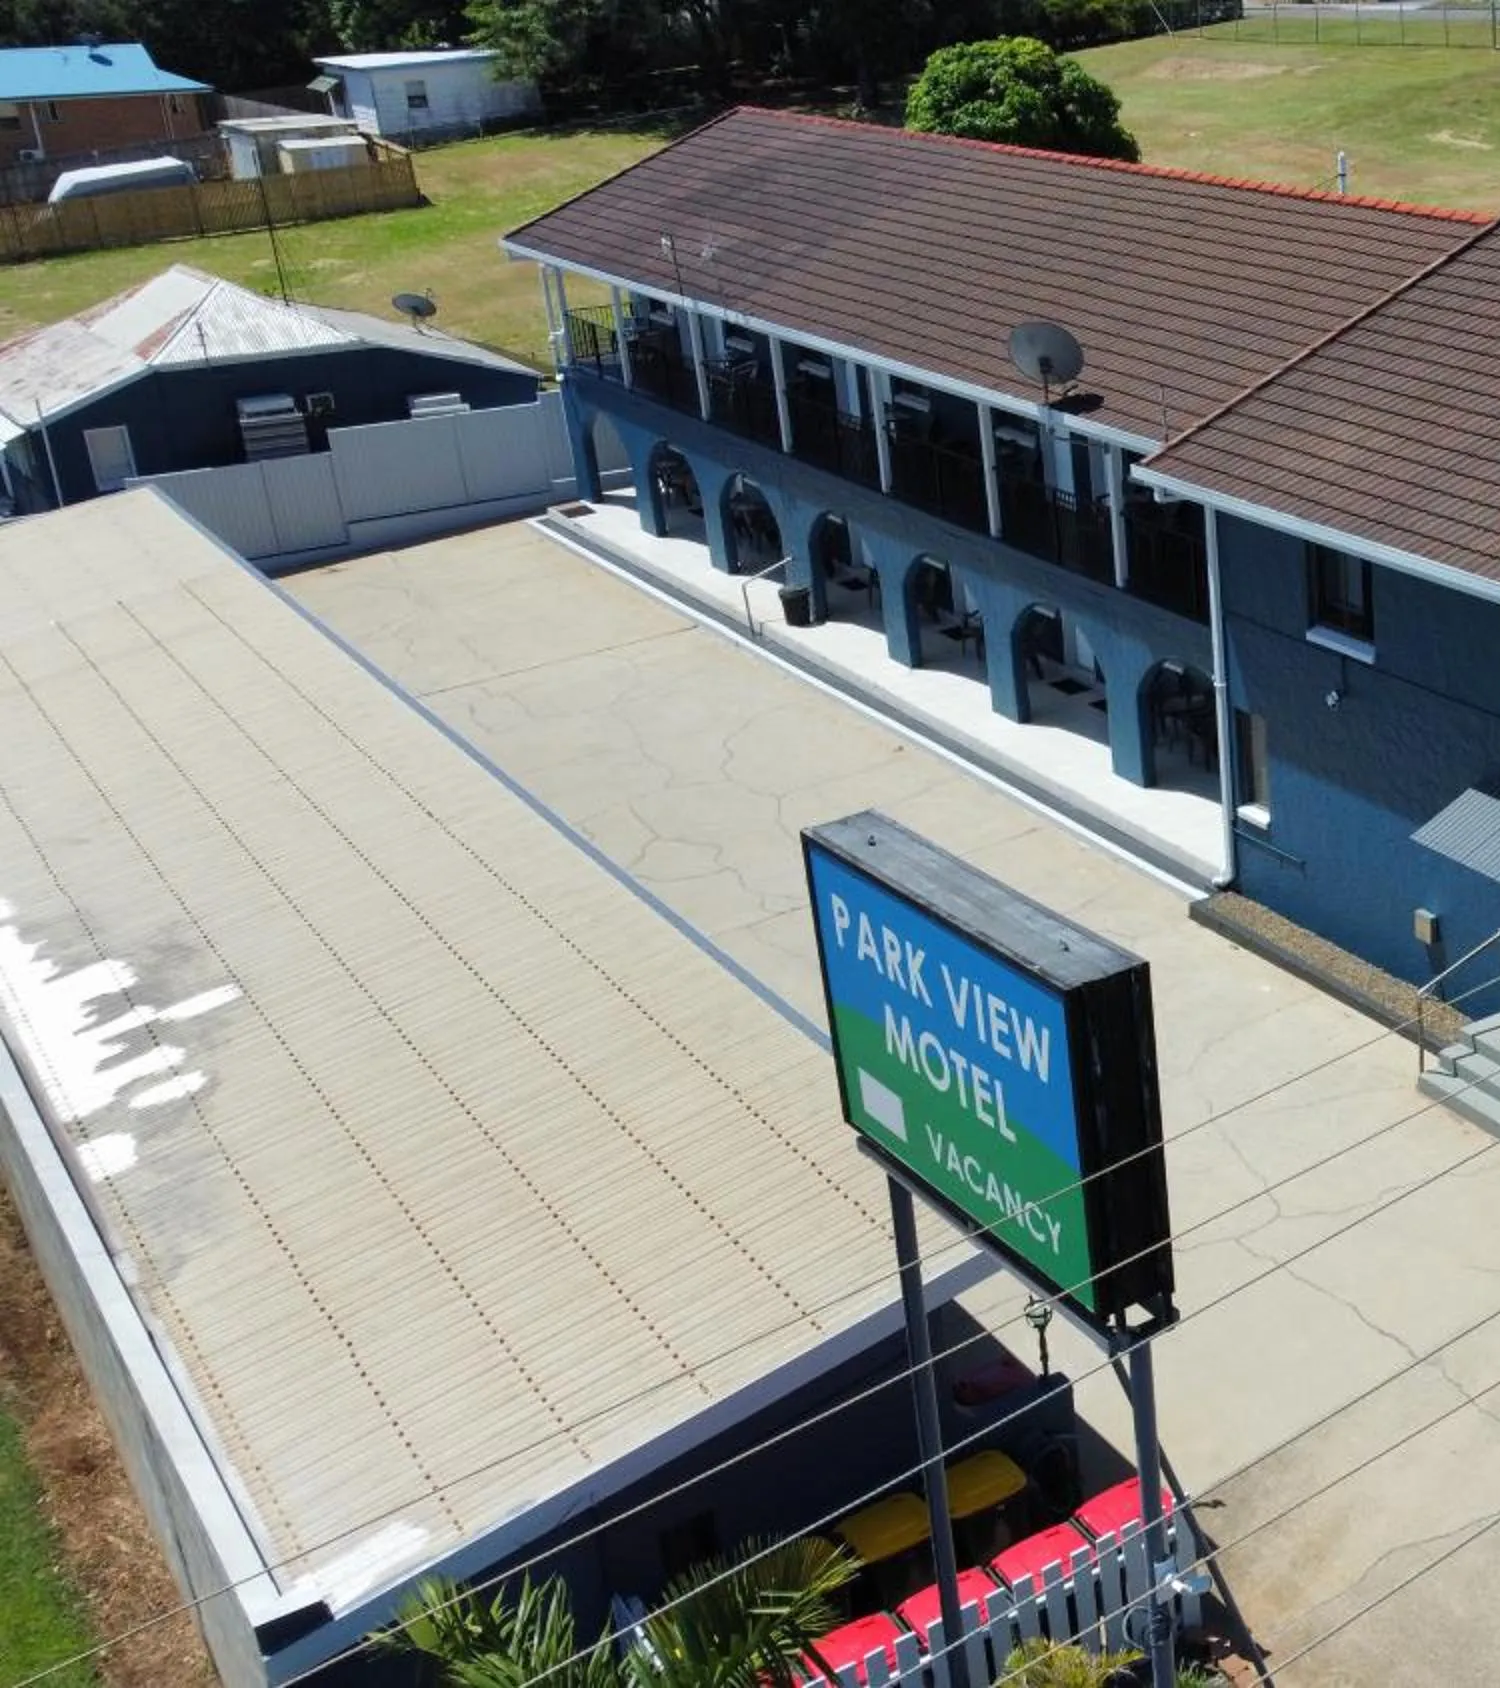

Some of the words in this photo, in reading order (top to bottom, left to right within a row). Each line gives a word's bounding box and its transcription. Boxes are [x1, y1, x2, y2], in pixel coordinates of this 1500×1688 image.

[830, 893, 933, 1008] PARK
[940, 964, 1051, 1083] VIEW
[884, 1004, 1018, 1144] MOTEL
[925, 1124, 1062, 1255] VACANCY
